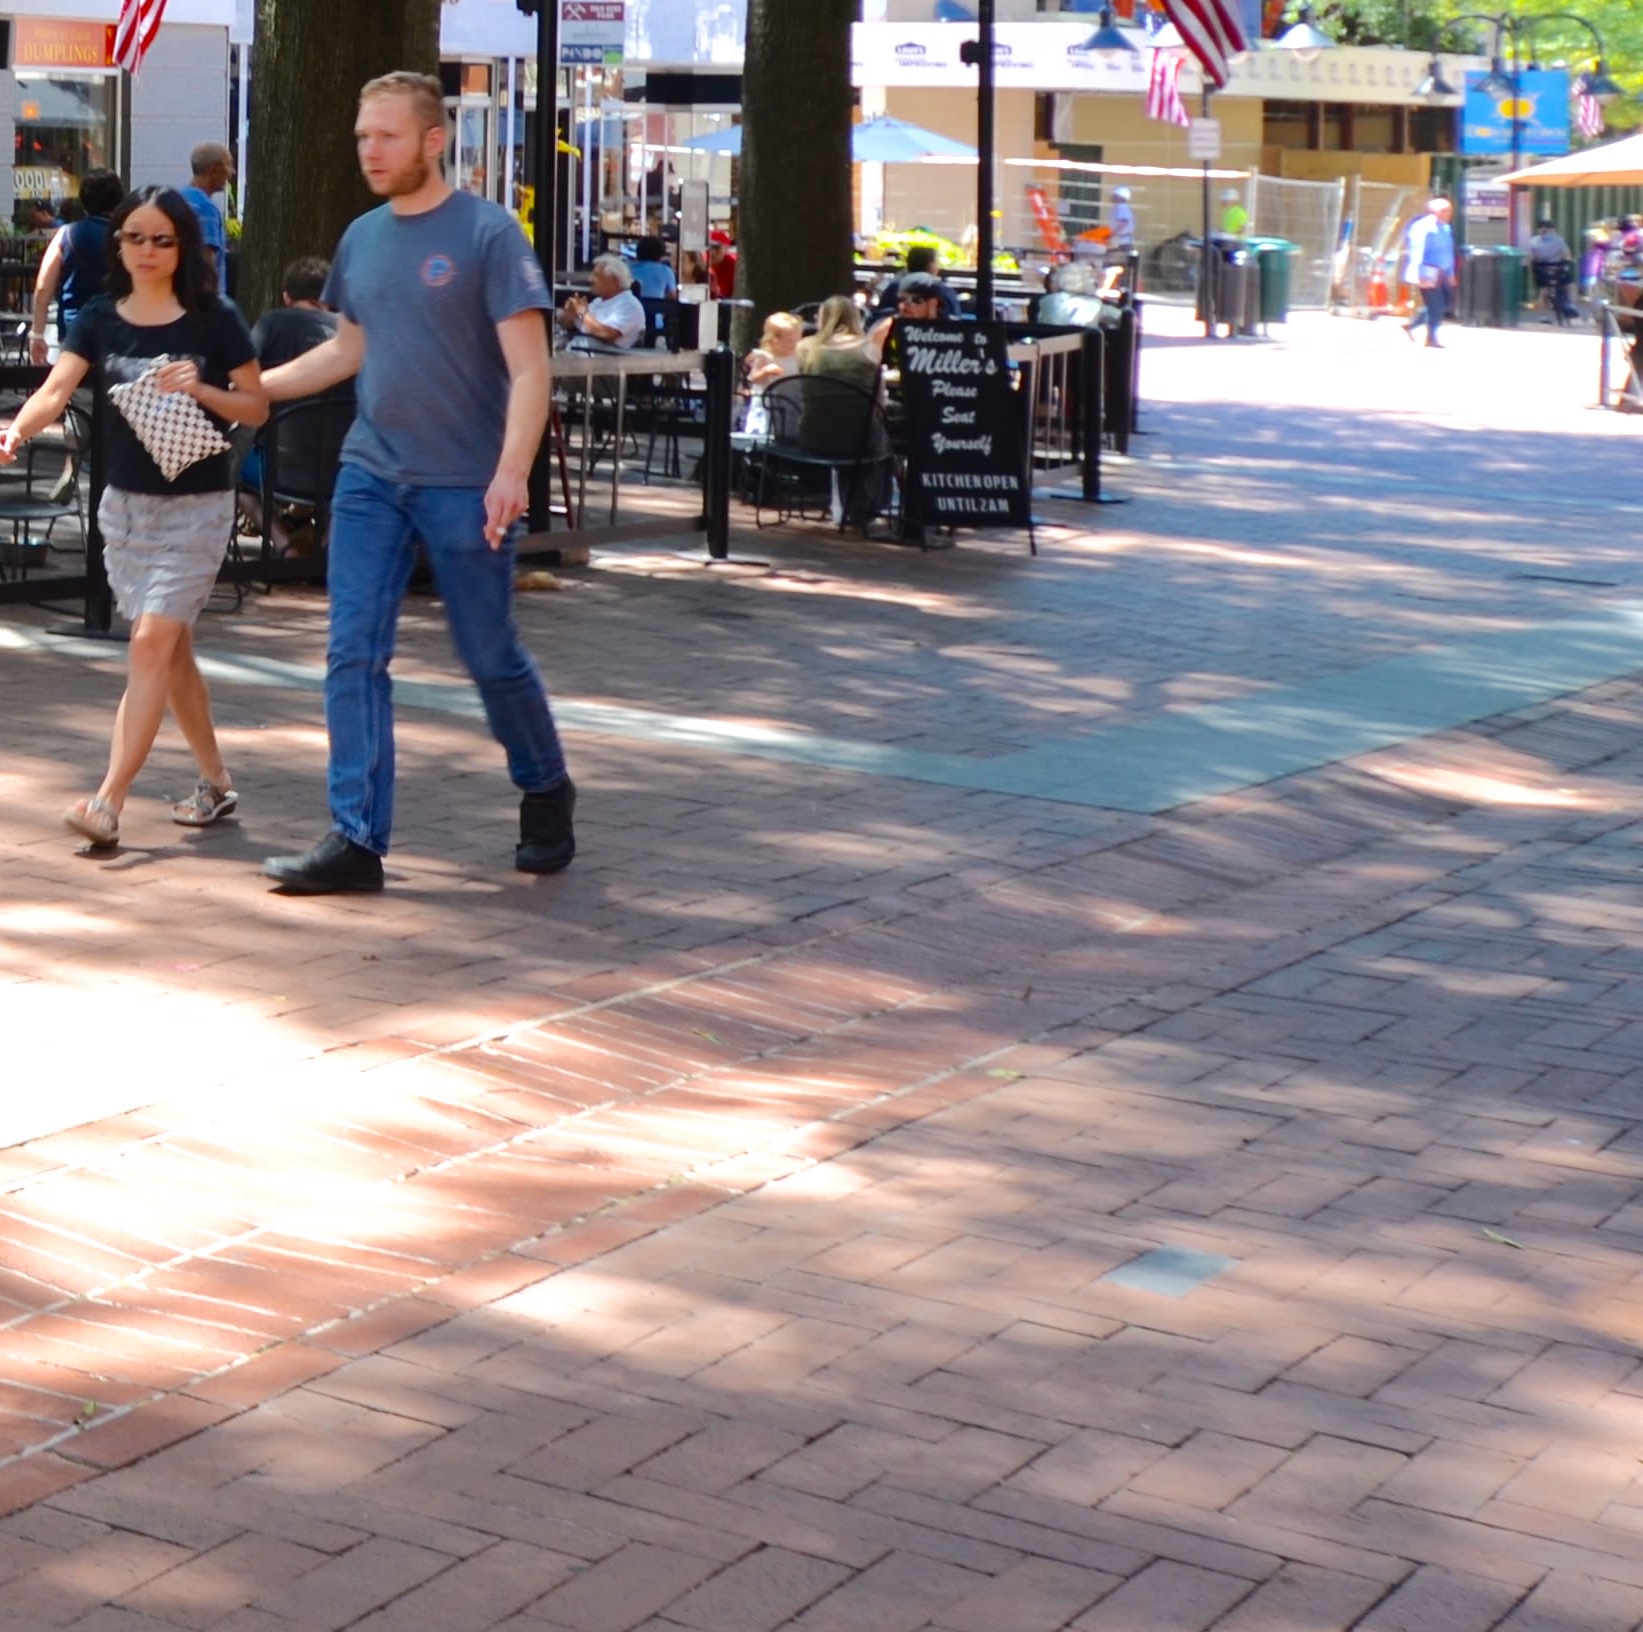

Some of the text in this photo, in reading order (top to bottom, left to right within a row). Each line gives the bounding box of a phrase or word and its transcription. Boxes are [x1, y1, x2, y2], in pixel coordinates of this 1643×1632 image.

[23, 43, 99, 64] DUMPLINGS
[904, 325, 988, 345] Welcome to
[906, 345, 998, 375] Miller's
[931, 379, 978, 398] Please
[941, 405, 976, 424] Seat
[930, 432, 993, 456] Yourself
[921, 473, 1019, 490] KITCHEN OPEN
[937, 496, 1010, 512] UNTIL 2AM
